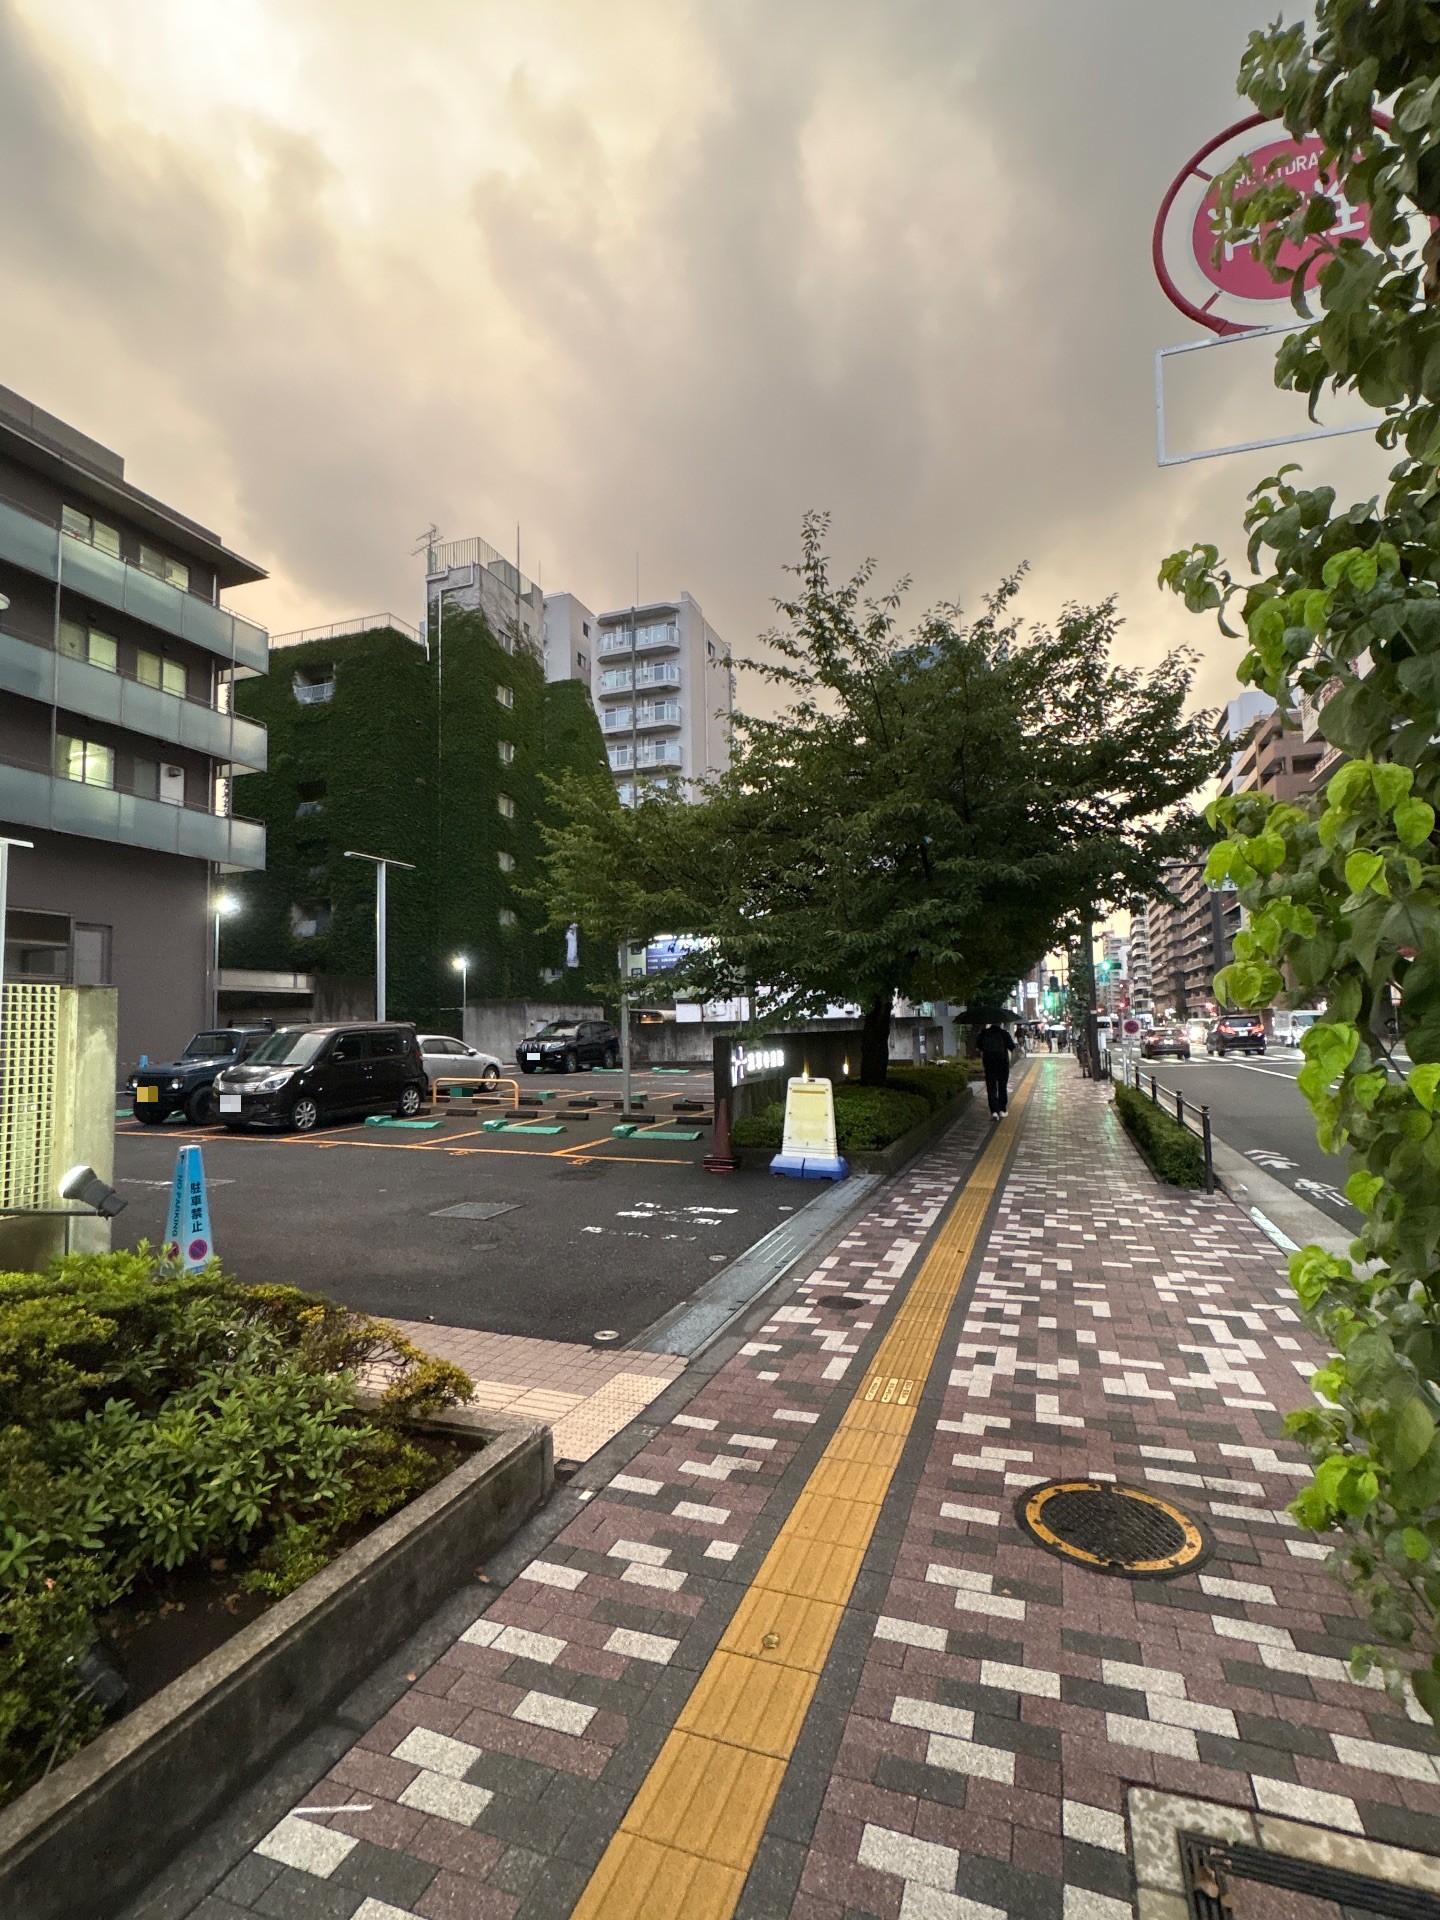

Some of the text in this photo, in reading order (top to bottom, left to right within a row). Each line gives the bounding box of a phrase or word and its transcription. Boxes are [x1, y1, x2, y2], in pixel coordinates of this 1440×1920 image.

[172, 1192, 182, 1237] PARKING
[190, 1182, 202, 1233] 駐車禁止
